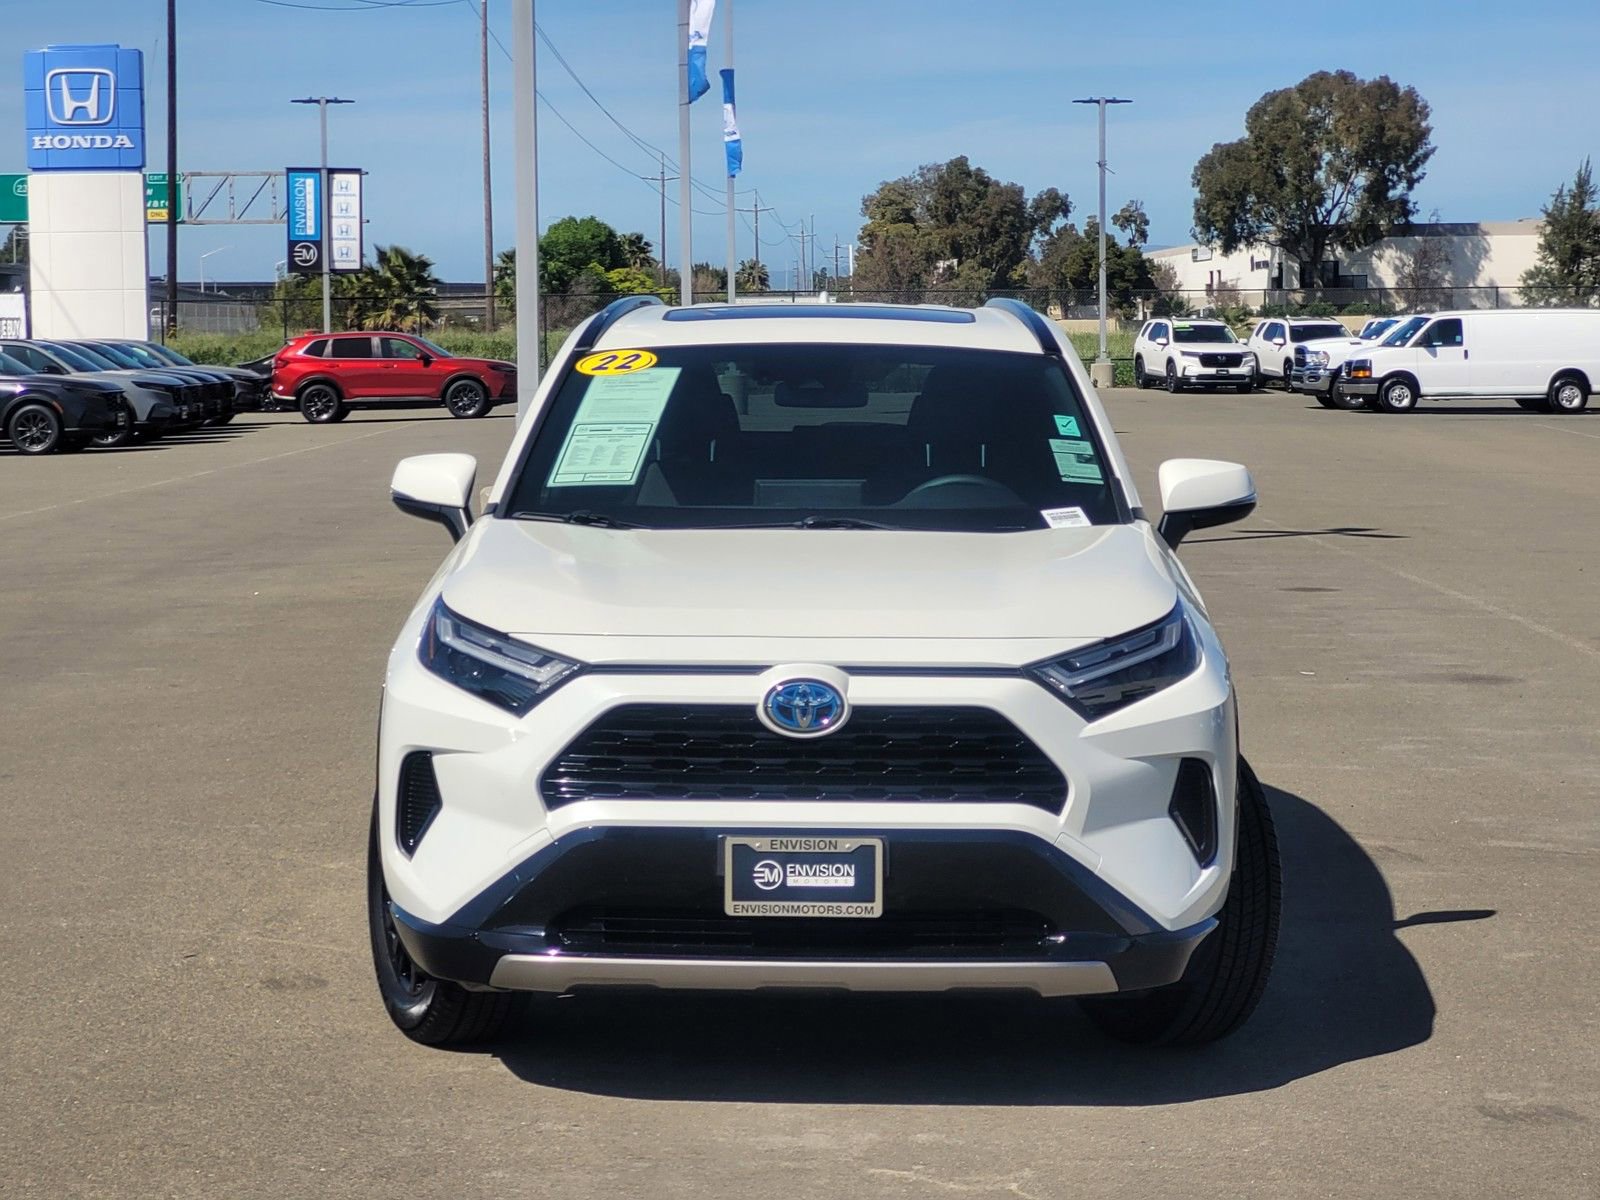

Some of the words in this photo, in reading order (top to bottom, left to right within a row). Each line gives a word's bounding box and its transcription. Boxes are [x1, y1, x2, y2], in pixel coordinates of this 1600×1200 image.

[32, 135, 135, 149] HONDA
[294, 178, 306, 236] ENVISION
[591, 353, 642, 371] 22
[769, 839, 838, 850] ENVISION
[786, 864, 855, 877] ENVISION
[733, 904, 875, 916] ENVISIONMOTORS.COM
